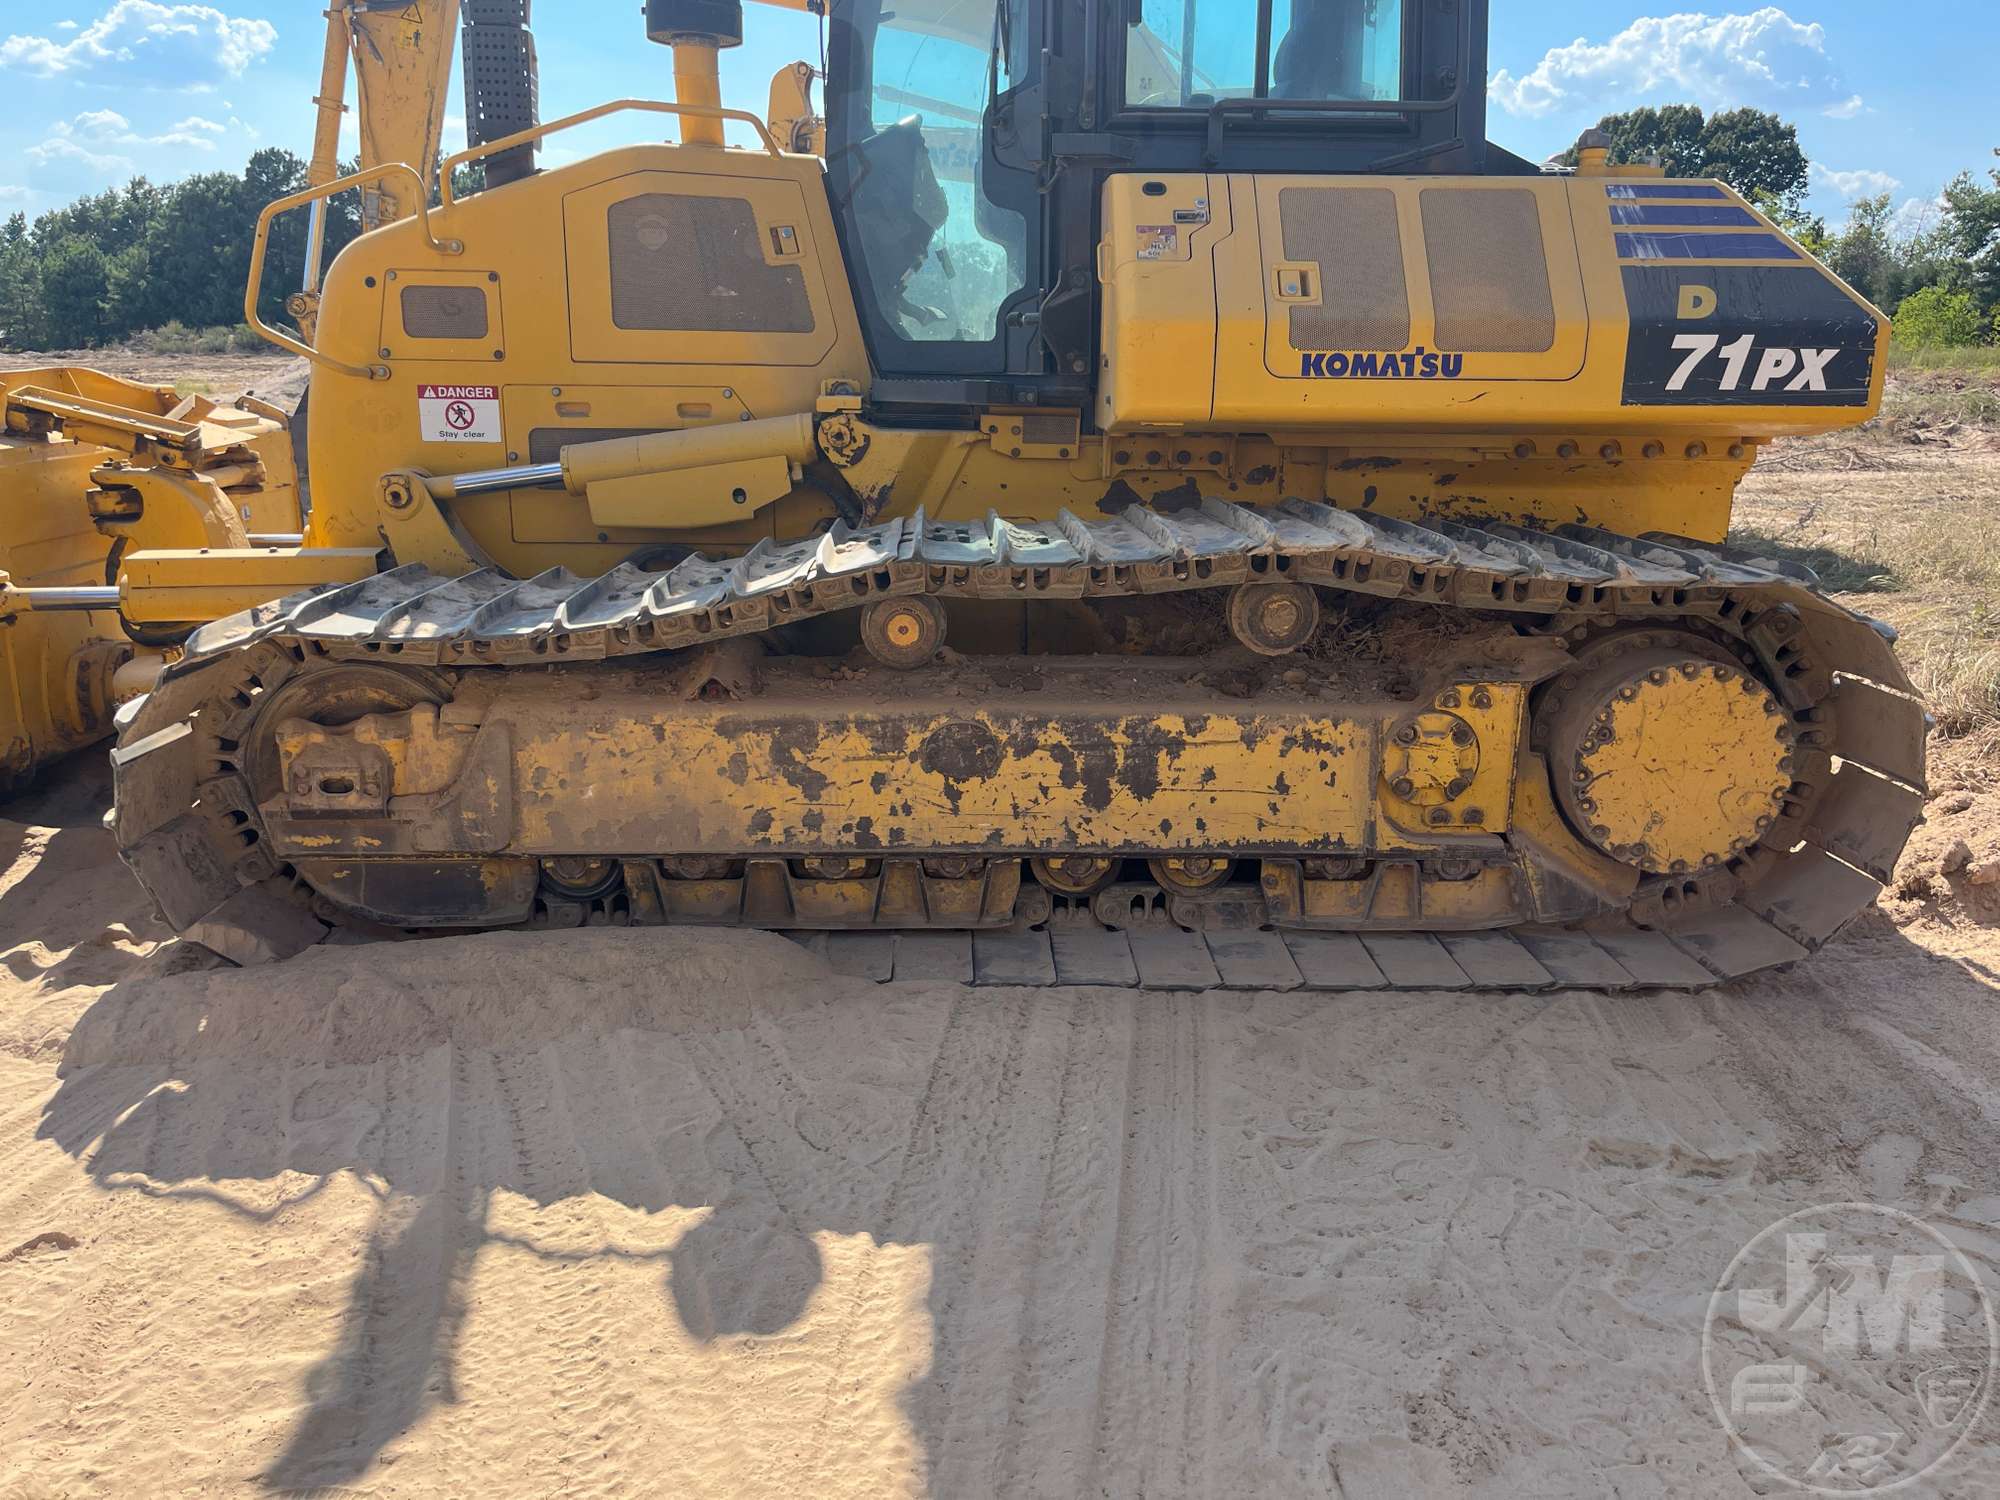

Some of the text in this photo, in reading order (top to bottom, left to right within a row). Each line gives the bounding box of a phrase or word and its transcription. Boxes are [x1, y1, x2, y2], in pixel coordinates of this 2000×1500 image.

[1676, 284, 1718, 320] D
[1301, 346, 1463, 378] KOMATSU
[1664, 334, 1841, 391] 71PX
[437, 386, 494, 398] DANGER
[439, 430, 486, 439] Stay clear
